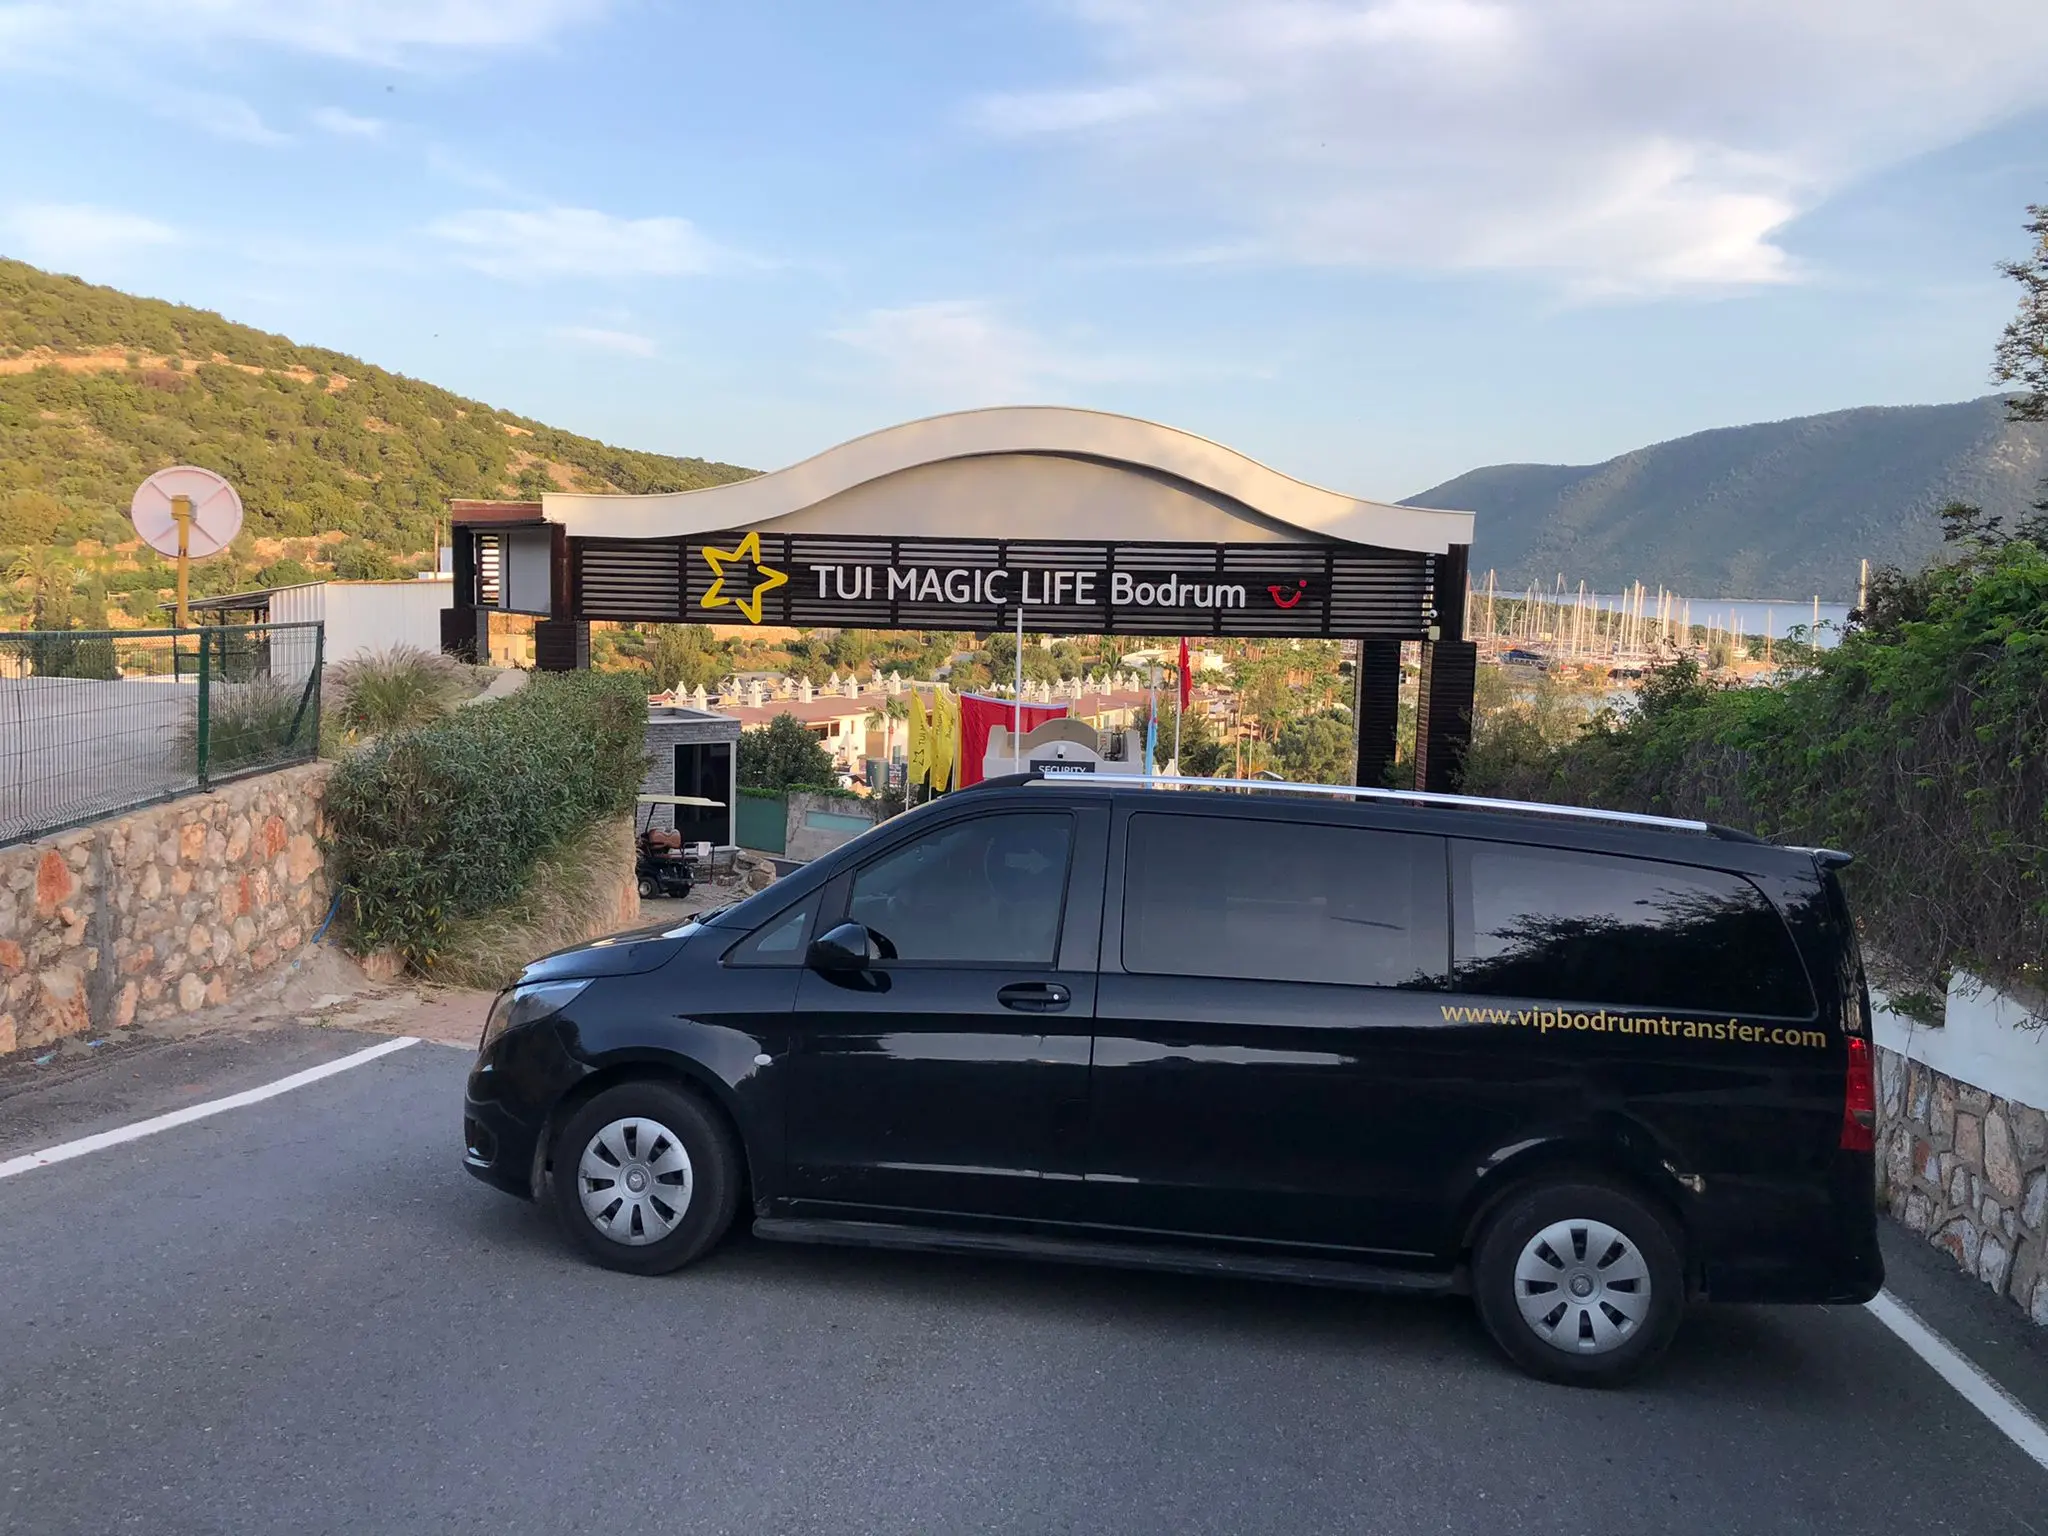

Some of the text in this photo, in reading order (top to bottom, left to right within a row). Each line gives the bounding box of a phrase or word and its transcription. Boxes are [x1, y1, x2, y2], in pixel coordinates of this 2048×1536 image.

[809, 565, 1246, 608] TUI MAGIC LIFE Bodrum
[1038, 765, 1087, 773] SECURITY
[1441, 1004, 1827, 1047] www.vipbodrumtransfer.com
